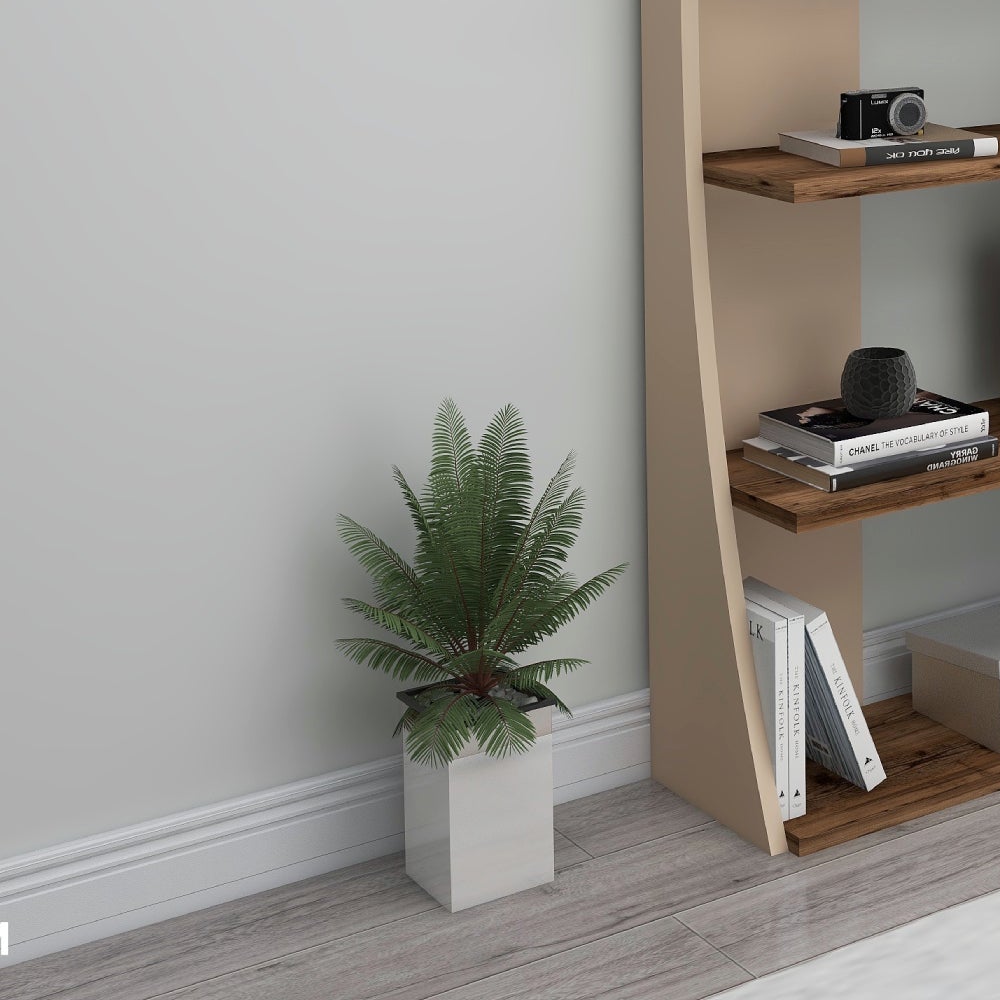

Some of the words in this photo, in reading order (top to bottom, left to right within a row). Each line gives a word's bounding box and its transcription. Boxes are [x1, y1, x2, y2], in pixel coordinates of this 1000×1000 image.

[886, 151, 905, 160] OK
[848, 443, 880, 457] CHANEL
[881, 440, 894, 450] THE
[939, 430, 948, 439] OF
[949, 424, 969, 437] STYLE
[792, 683, 800, 737] KINFOLK
[834, 675, 855, 720] KINFOLK
